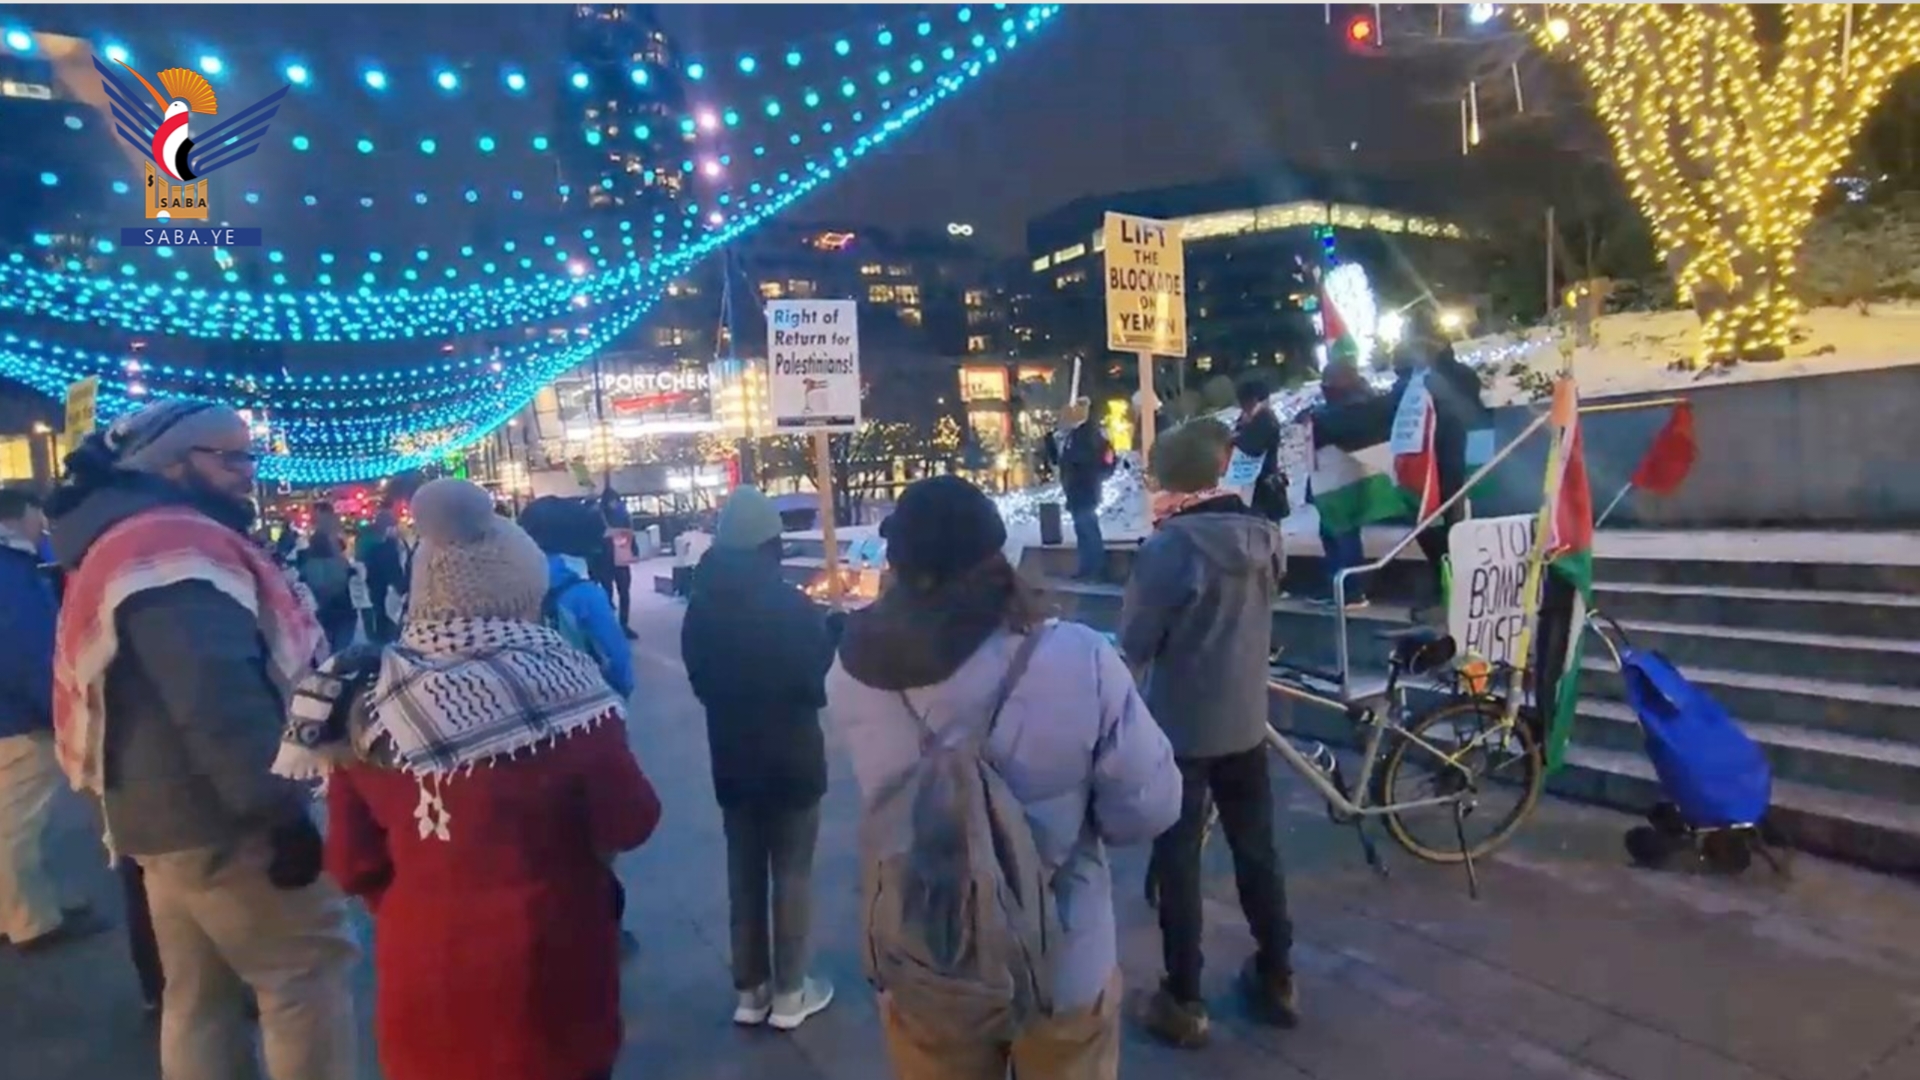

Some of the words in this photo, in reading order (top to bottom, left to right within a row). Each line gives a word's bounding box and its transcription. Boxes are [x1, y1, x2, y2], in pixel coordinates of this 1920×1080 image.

[1121, 220, 1165, 247] LIFT
[1134, 250, 1159, 265] THE
[1110, 267, 1181, 296] BLOCKADE
[774, 308, 817, 328] Right
[823, 308, 839, 323] of
[1119, 312, 1175, 334] YEMN
[774, 330, 827, 345] Return
[831, 332, 850, 346] for
[775, 351, 854, 375] Palestinians!
[1469, 562, 1543, 619] BOMB
[1466, 614, 1526, 668] HOSP
